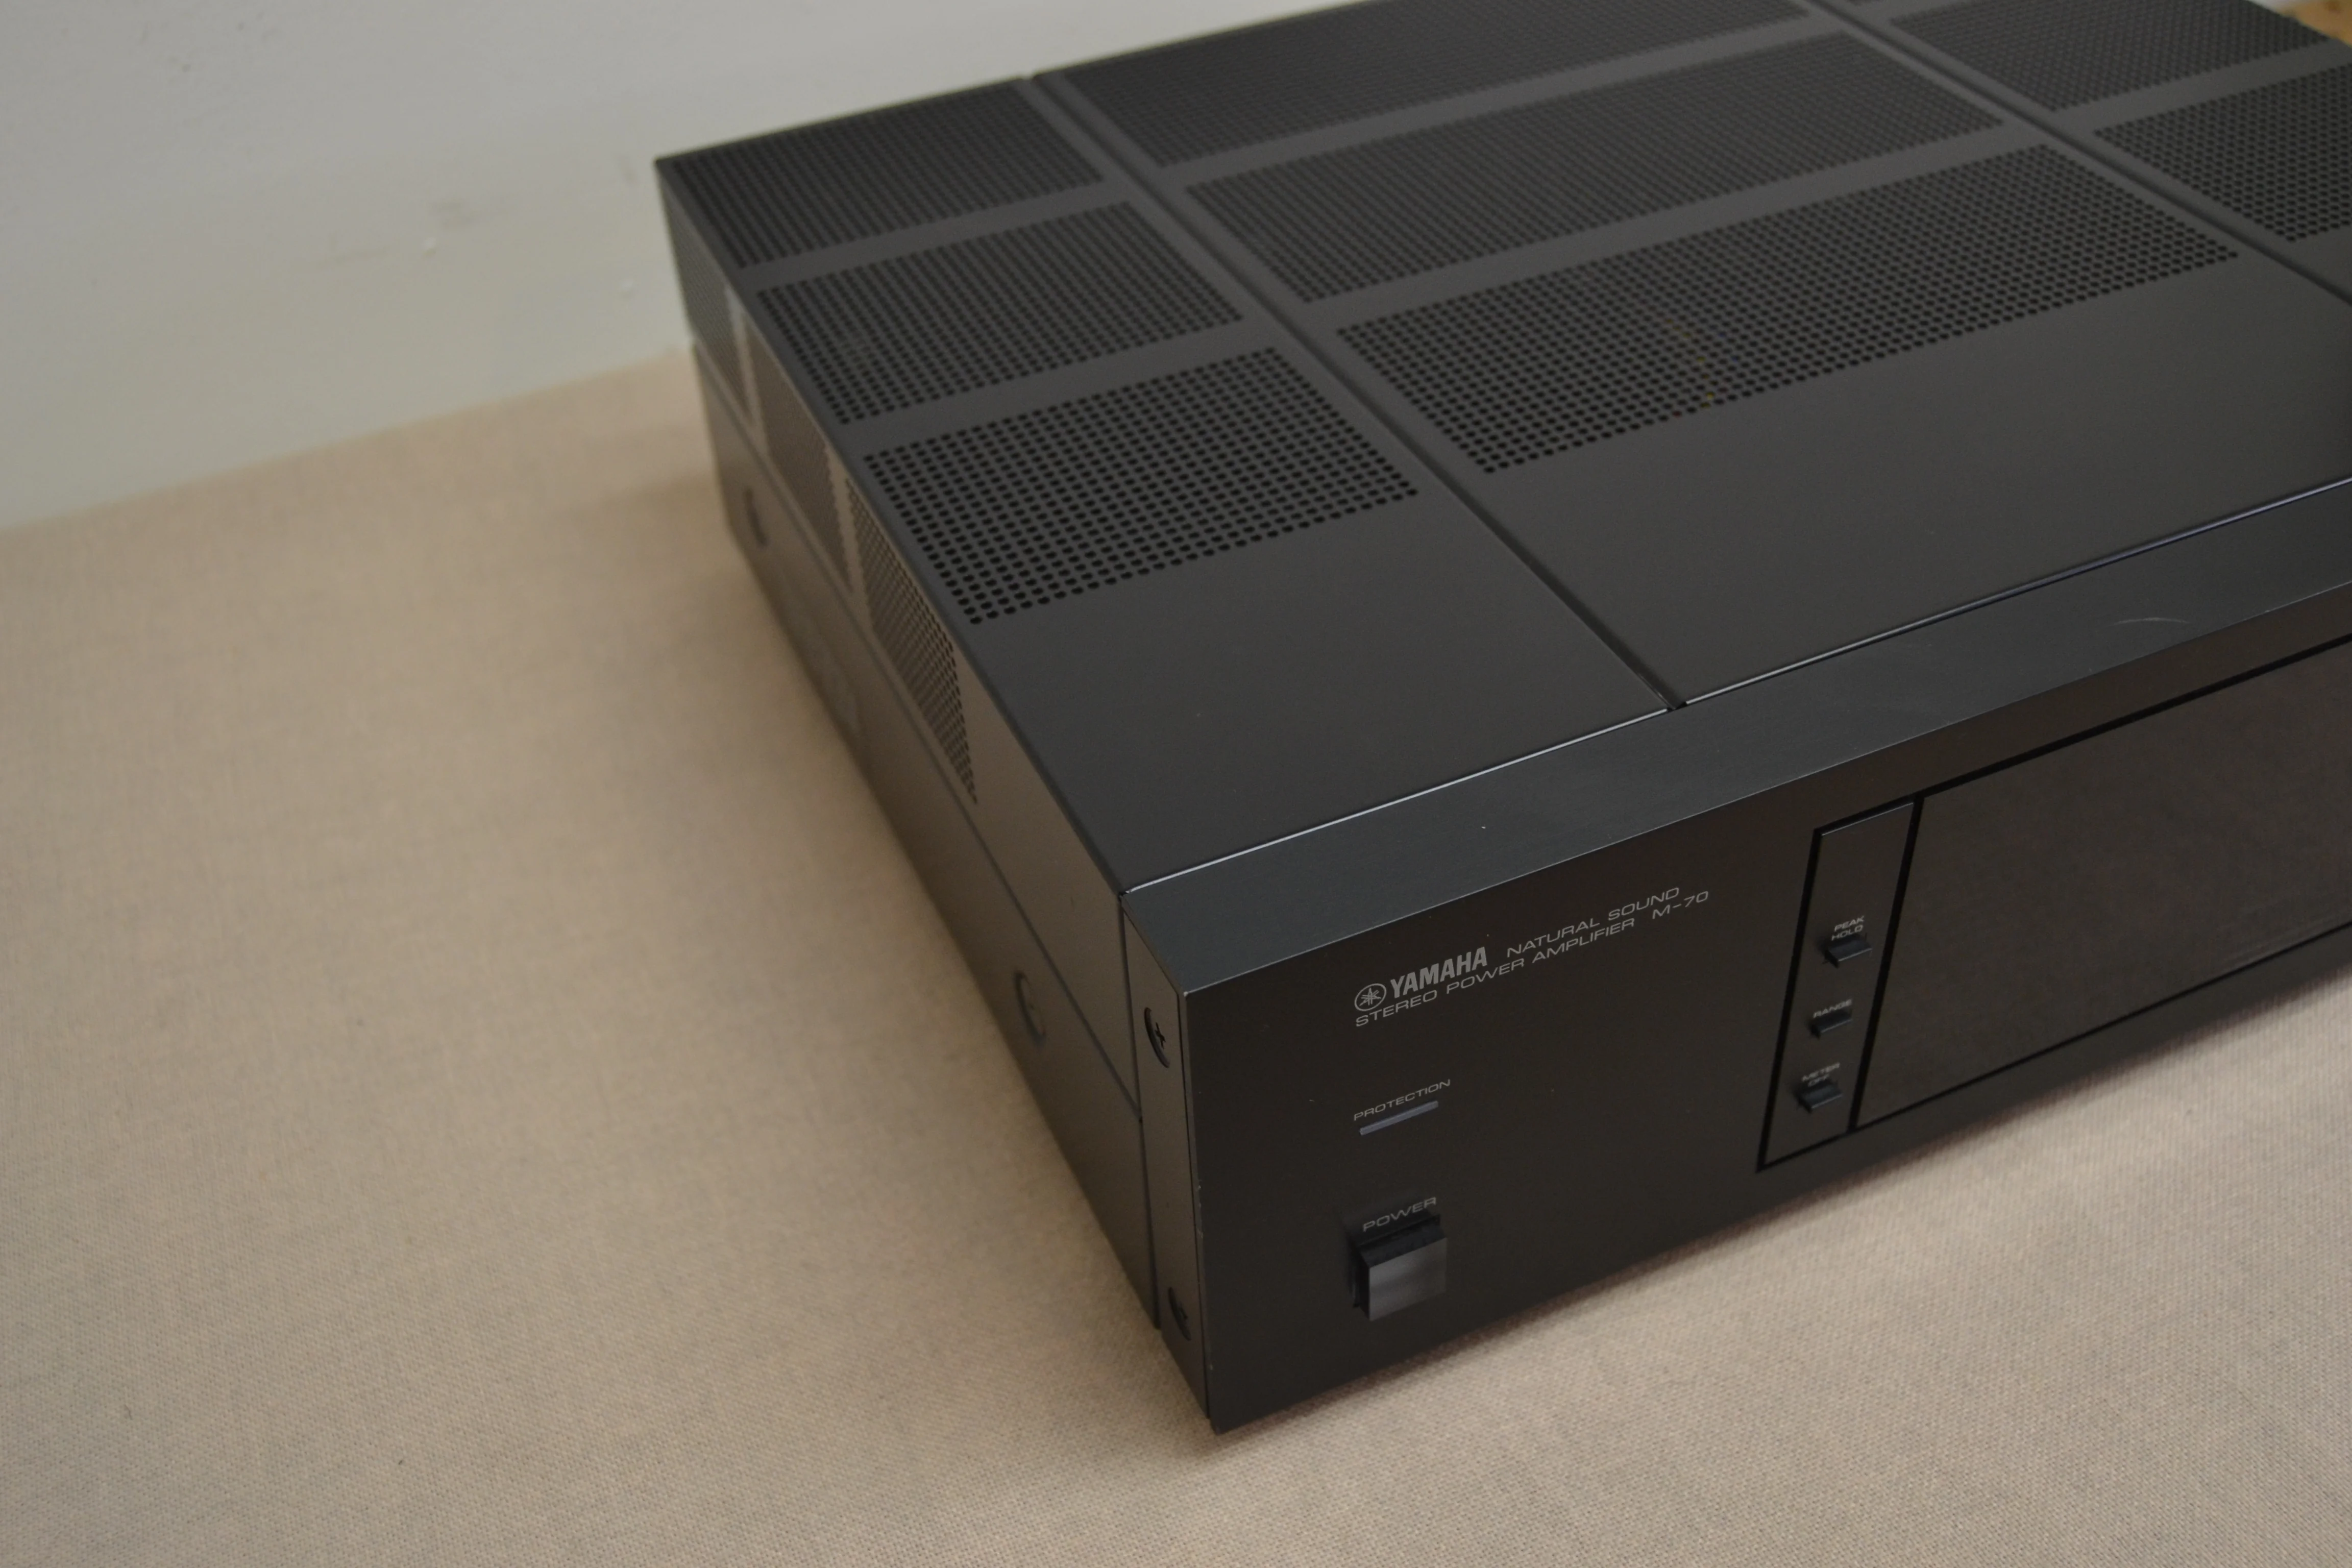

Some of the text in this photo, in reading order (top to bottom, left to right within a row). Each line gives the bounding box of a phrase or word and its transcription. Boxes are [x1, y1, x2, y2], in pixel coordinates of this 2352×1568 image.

[1507, 888, 1680, 958] NATURAL SOUND
[1831, 924, 1864, 941] HOLD
[1833, 915, 1865, 932] PEAK
[1356, 891, 1709, 1027] STEREO POWER AMPLIFIER M-70
[1390, 946, 1488, 999] YAMAHA
[1354, 1079, 1451, 1121] PROTECTION
[1363, 1196, 1437, 1232] POWER
